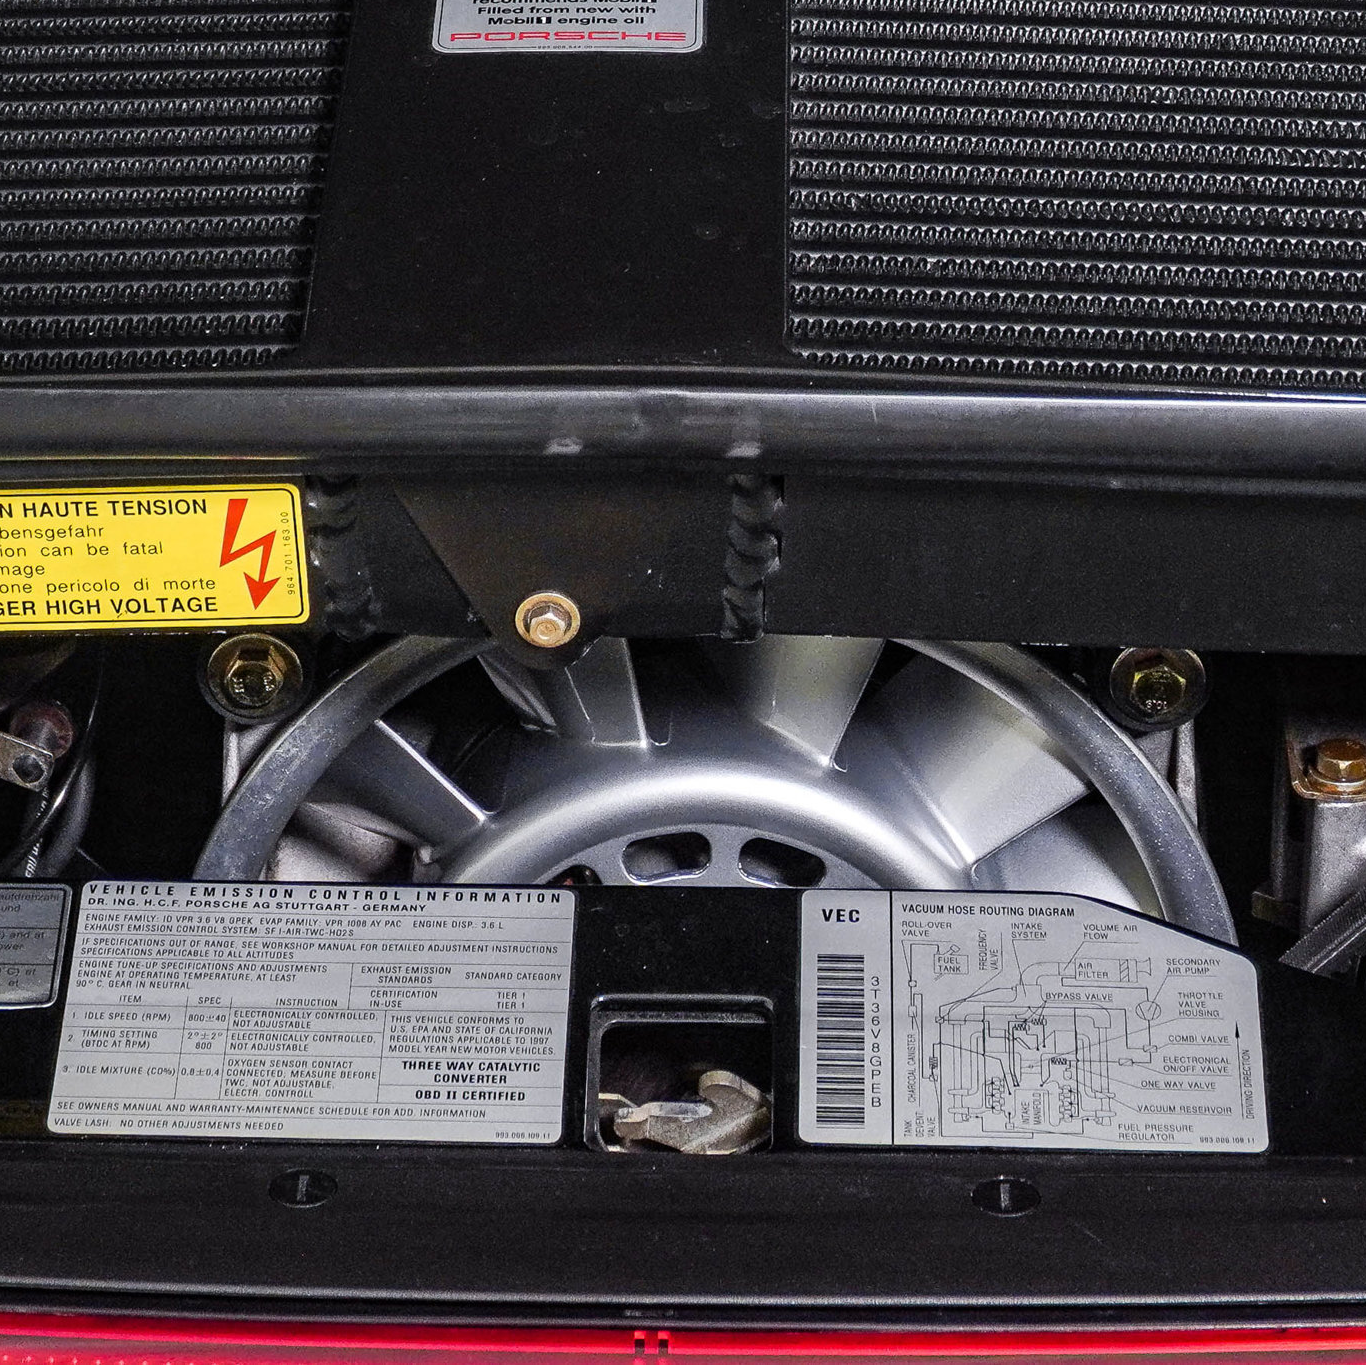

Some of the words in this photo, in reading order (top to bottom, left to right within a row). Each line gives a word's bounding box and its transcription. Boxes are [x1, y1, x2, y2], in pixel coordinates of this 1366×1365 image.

[477, 5, 524, 15] Filled
[528, 5, 570, 14] from
[618, 5, 656, 14] with
[557, 17, 618, 26] engine
[623, 16, 644, 25] oil
[450, 31, 686, 42] PORSCHE
[22, 501, 99, 518] HAUTE
[106, 498, 207, 516] TENSION
[40, 546, 73, 557] can
[86, 542, 109, 556] be
[122, 541, 163, 555] fatal
[46, 578, 120, 597] pericolo
[133, 577, 149, 592] di
[163, 577, 216, 591] morte
[45, 598, 101, 616] HIGH
[110, 596, 218, 615] VOLTAGE
[89, 884, 175, 896] VEHICLE
[189, 886, 294, 899] EMISSION
[308, 888, 401, 901] CONTROL
[416, 890, 561, 904] INFORMATION
[87, 897, 108, 906] DR.
[113, 897, 139, 907] ING.
[185, 899, 248, 909] PORSCHE
[252, 901, 270, 910] AG
[275, 901, 350, 912] STUTTGART
[362, 903, 427, 912] GERMANY
[821, 908, 860, 923] VEC
[901, 903, 944, 914] VACUUM
[947, 904, 976, 916] HOSE
[979, 905, 1024, 917] ROUTING
[1028, 906, 1075, 919] DIAGRAM
[901, 920, 953, 930] ROLL-OVER
[901, 929, 930, 938] VALVE
[937, 956, 961, 965] FUEL
[1077, 962, 1093, 970] AIR
[938, 964, 961, 974] TANK
[1078, 970, 1109, 980] FILTER
[370, 989, 438, 999] CERTIFICATION
[497, 990, 518, 1003] TIER
[522, 992, 526, 1000] 1
[1045, 992, 1080, 1001] BYPASS
[1085, 992, 1113, 1001] VALVE
[275, 998, 338, 1008] INSTRUCTION
[369, 999, 402, 1009] IN-USE
[496, 1001, 517, 1010] TIER
[521, 1001, 525, 1009] 1
[1167, 1034, 1198, 1045] COMBI
[1200, 1034, 1229, 1045] VALVE
[401, 1060, 442, 1071] THREE
[446, 1060, 474, 1071] WAY
[478, 1061, 541, 1073] CATALYTIC
[434, 1073, 507, 1084] CONVERTER
[415, 1089, 441, 1100] OBD
[446, 1090, 457, 1100] II
[462, 1090, 526, 1102] CERTIFIED
